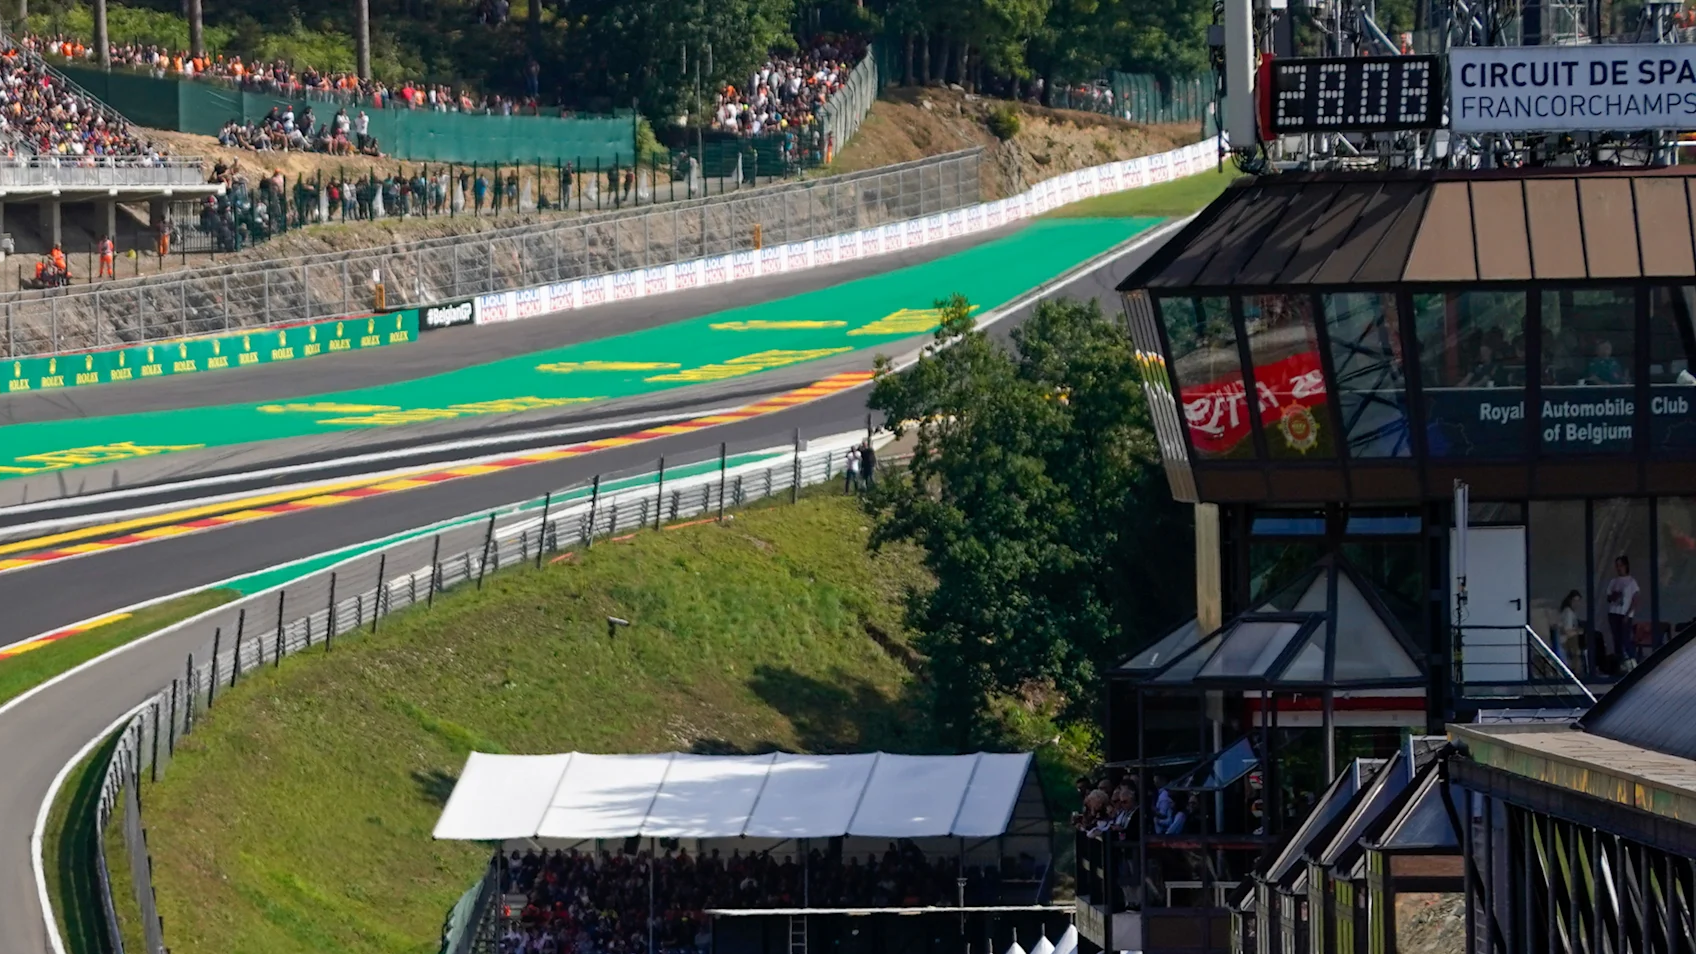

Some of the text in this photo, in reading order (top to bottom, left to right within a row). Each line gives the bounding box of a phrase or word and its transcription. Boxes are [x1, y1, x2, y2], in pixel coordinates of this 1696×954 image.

[1461, 58, 1696, 88] CIRCUIT DE SPA
[1277, 62, 1430, 126] 28.08
[1461, 94, 1696, 118] FRANCORCHAMPS
[550, 284, 572, 297] LIQUI
[582, 278, 604, 291] LIQUI
[481, 293, 507, 306] LIQUI
[516, 289, 540, 302] LIQUI
[582, 290, 605, 304] MOLY
[517, 302, 541, 317] MOLY
[550, 296, 573, 311] MOLY
[427, 303, 473, 325] #BelgianGP
[482, 307, 508, 322] MOLY
[1480, 397, 1689, 424] Royal Automobile Club
[1544, 423, 1632, 444] of Belgium
